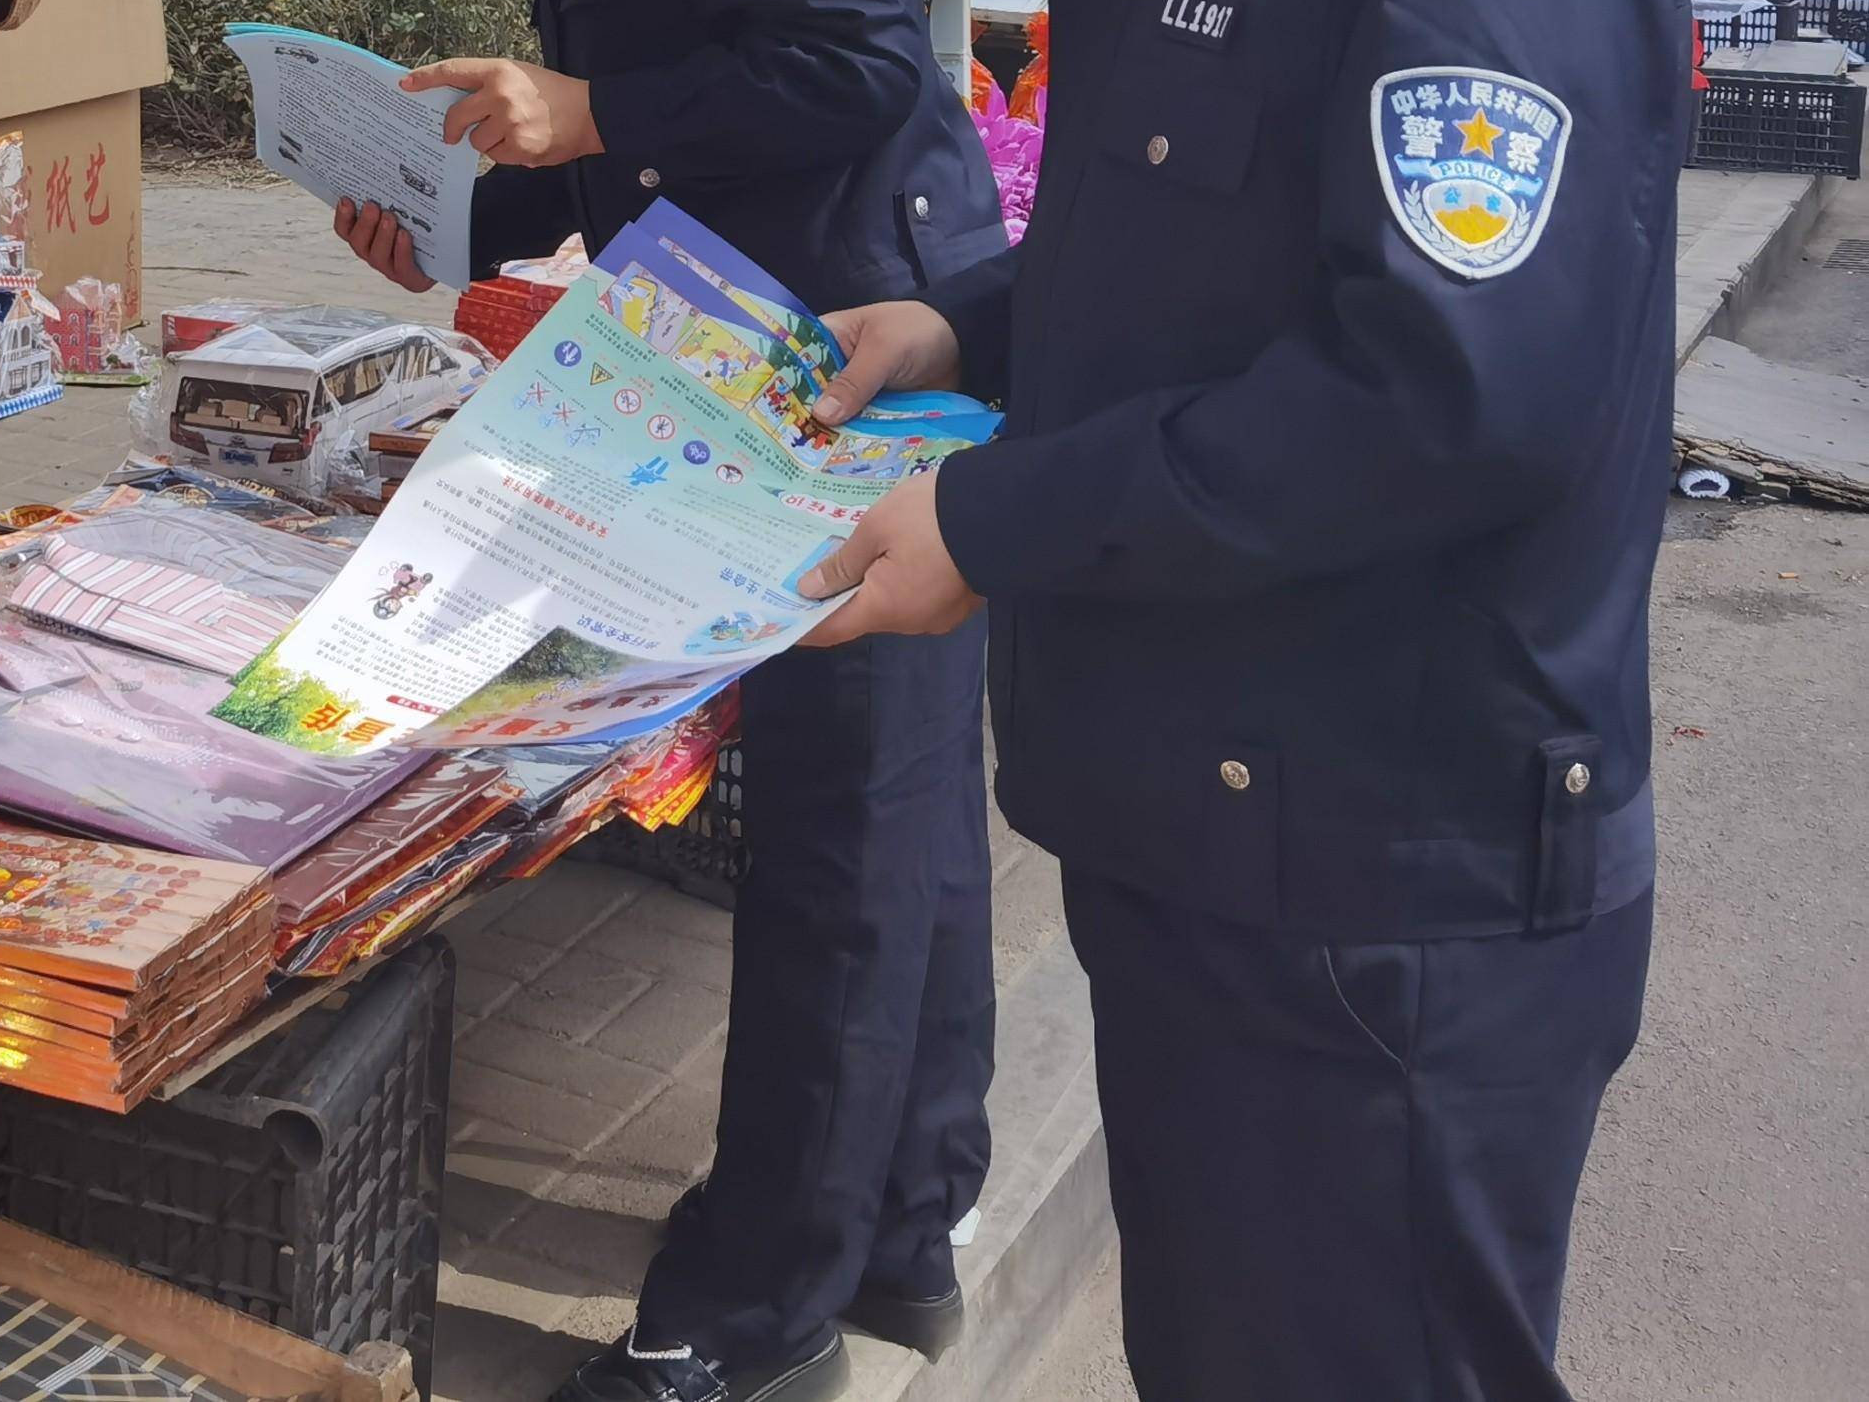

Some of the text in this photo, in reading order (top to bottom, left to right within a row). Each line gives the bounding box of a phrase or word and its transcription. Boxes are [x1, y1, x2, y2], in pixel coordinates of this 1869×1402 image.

[1390, 80, 1558, 142] 中华人民共和国
[1438, 160, 1510, 189] POLICE
[717, 564, 761, 598] 生命带
[575, 613, 660, 650] 步行安全常识
[299, 699, 415, 745] 宣传
